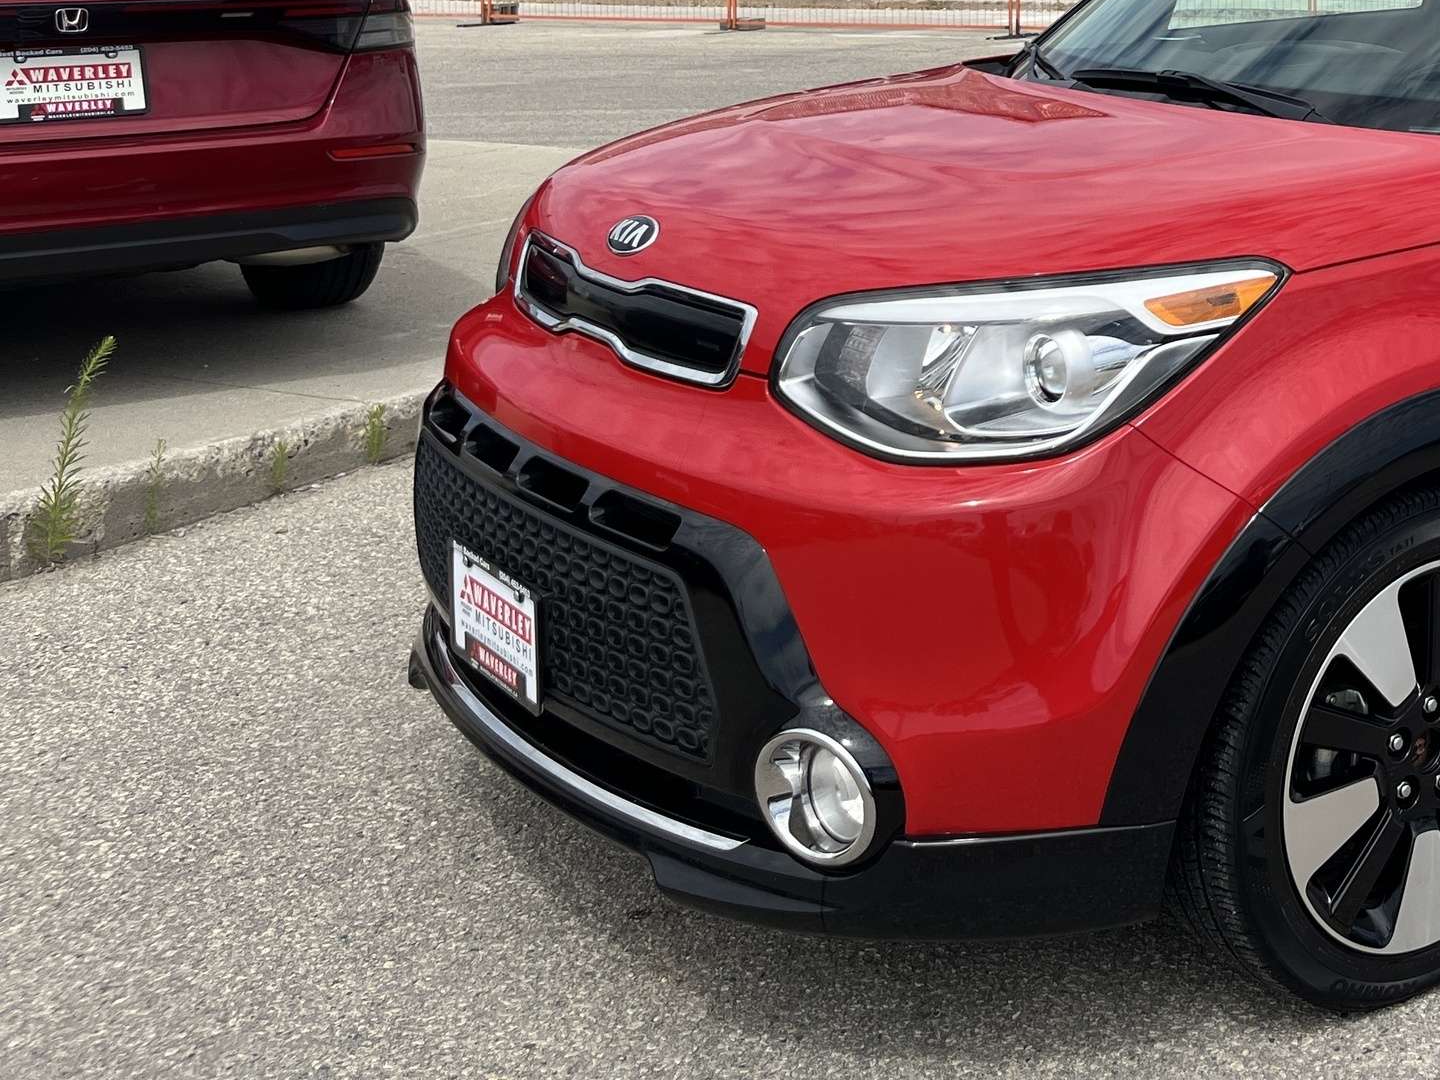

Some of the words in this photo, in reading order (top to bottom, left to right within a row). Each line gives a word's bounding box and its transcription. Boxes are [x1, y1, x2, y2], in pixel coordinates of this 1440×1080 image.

[30, 64, 131, 82] WAVERLEY
[33, 79, 133, 94] MITSUBISHI
[6, 90, 136, 104] waverleymitsubishi.com
[46, 99, 112, 113] WAVERLEY
[472, 581, 532, 642] WAVERLEY
[475, 608, 532, 663] MITSUBISHI
[479, 646, 518, 688] WAVERLEY
